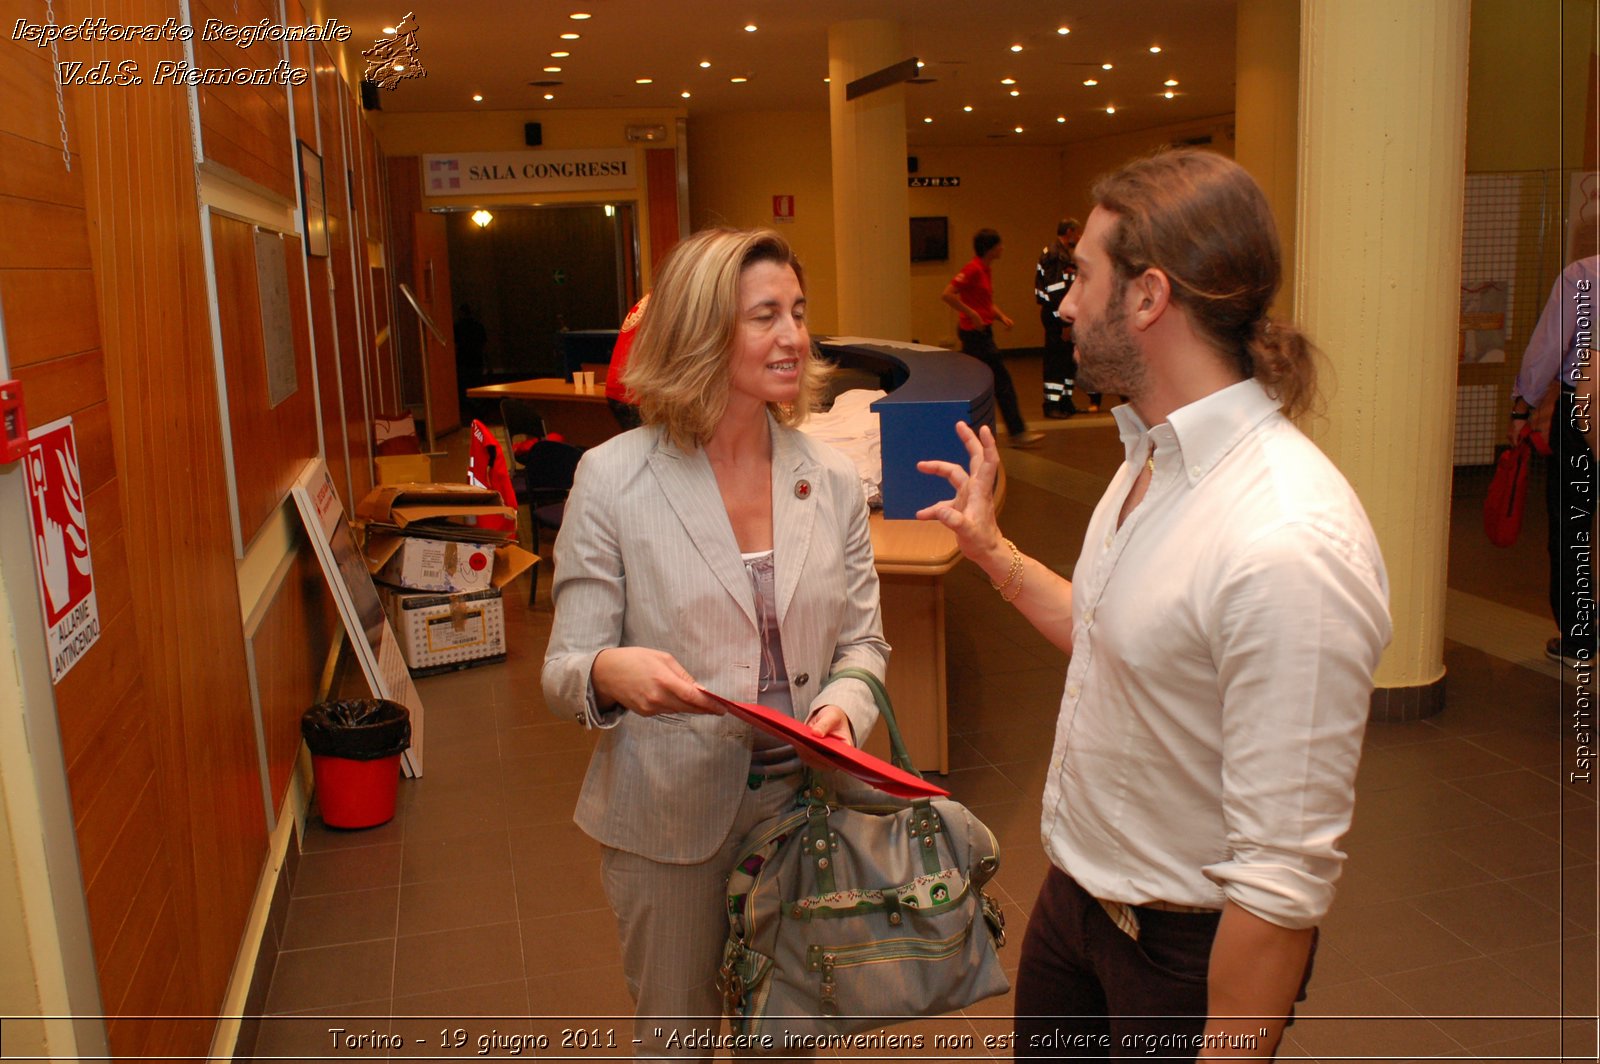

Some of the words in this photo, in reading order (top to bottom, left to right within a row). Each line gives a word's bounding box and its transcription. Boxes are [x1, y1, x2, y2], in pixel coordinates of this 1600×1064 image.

[469, 165, 516, 181] SALA
[523, 161, 628, 179] CONGRESSI
[59, 600, 90, 645] ALLARME
[55, 618, 98, 677] ANTINCENDIO
